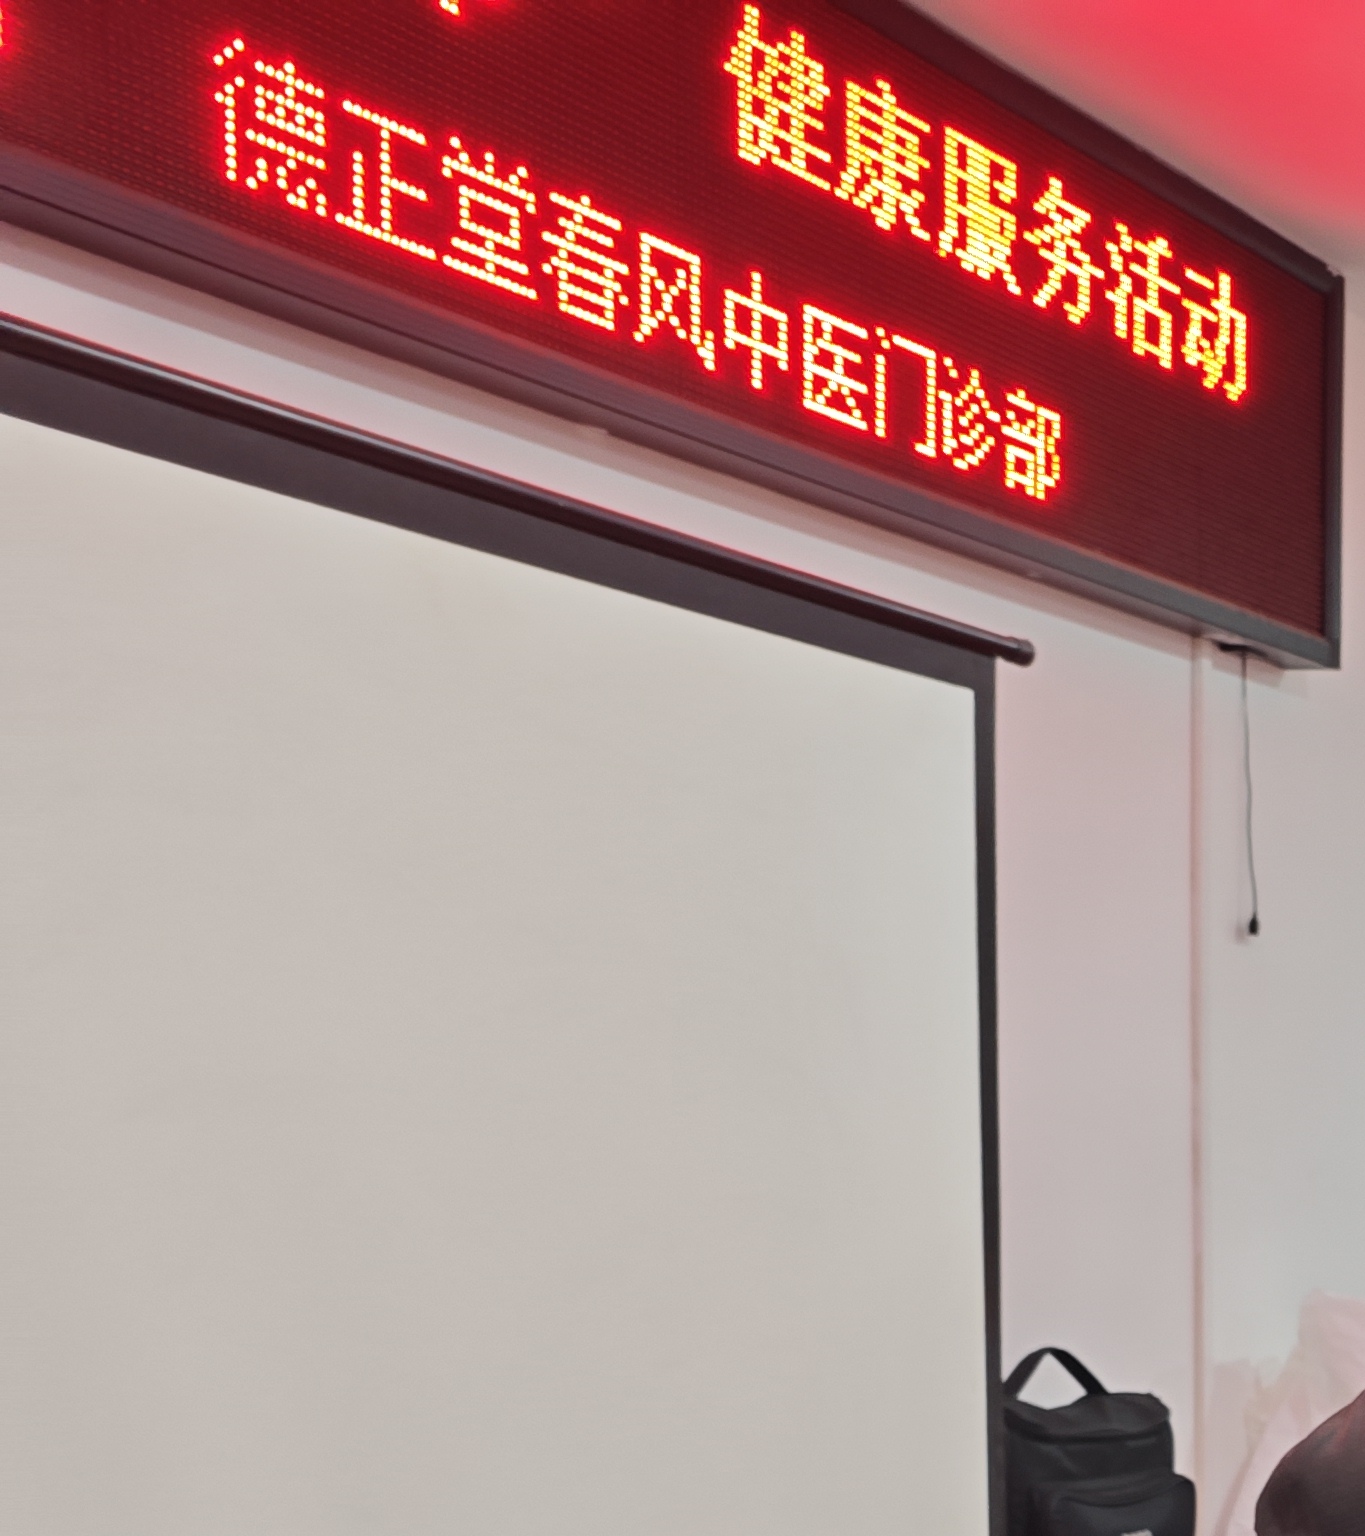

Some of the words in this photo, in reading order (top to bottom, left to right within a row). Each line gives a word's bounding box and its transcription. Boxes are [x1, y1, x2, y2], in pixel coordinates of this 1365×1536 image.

[211, 37, 1063, 501] 德正堂春风中医门诊部
[723, 4, 1248, 402] 健康服务活动
